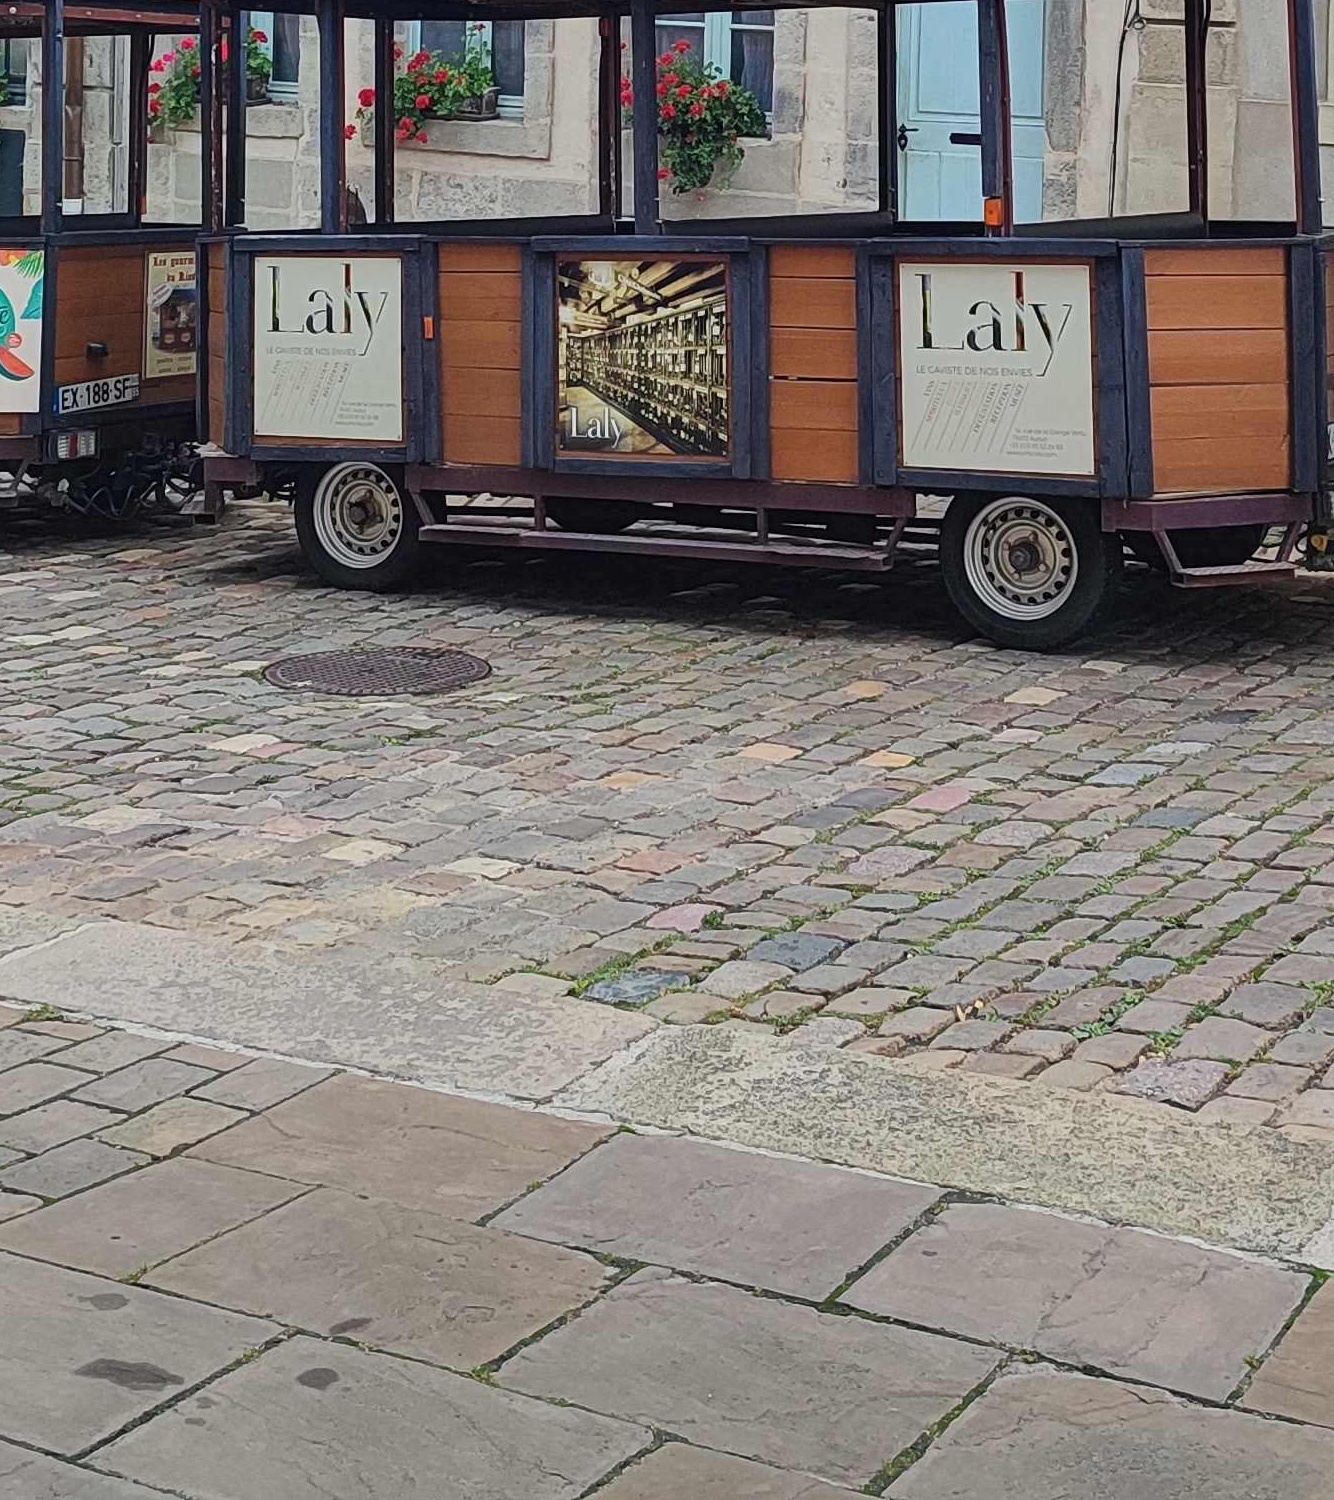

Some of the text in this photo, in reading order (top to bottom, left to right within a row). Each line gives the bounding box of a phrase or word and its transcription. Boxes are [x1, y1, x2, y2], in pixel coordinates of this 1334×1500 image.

[267, 263, 389, 356] Laly
[914, 271, 1073, 377] Laly
[265, 346, 357, 357] LE CAVISTE DE NOS ENVIES
[915, 365, 1033, 377] LE CAVISTE DE NOS ENVIES
[61, 377, 131, 411] EX-188-SF
[569, 406, 626, 448] Laly
